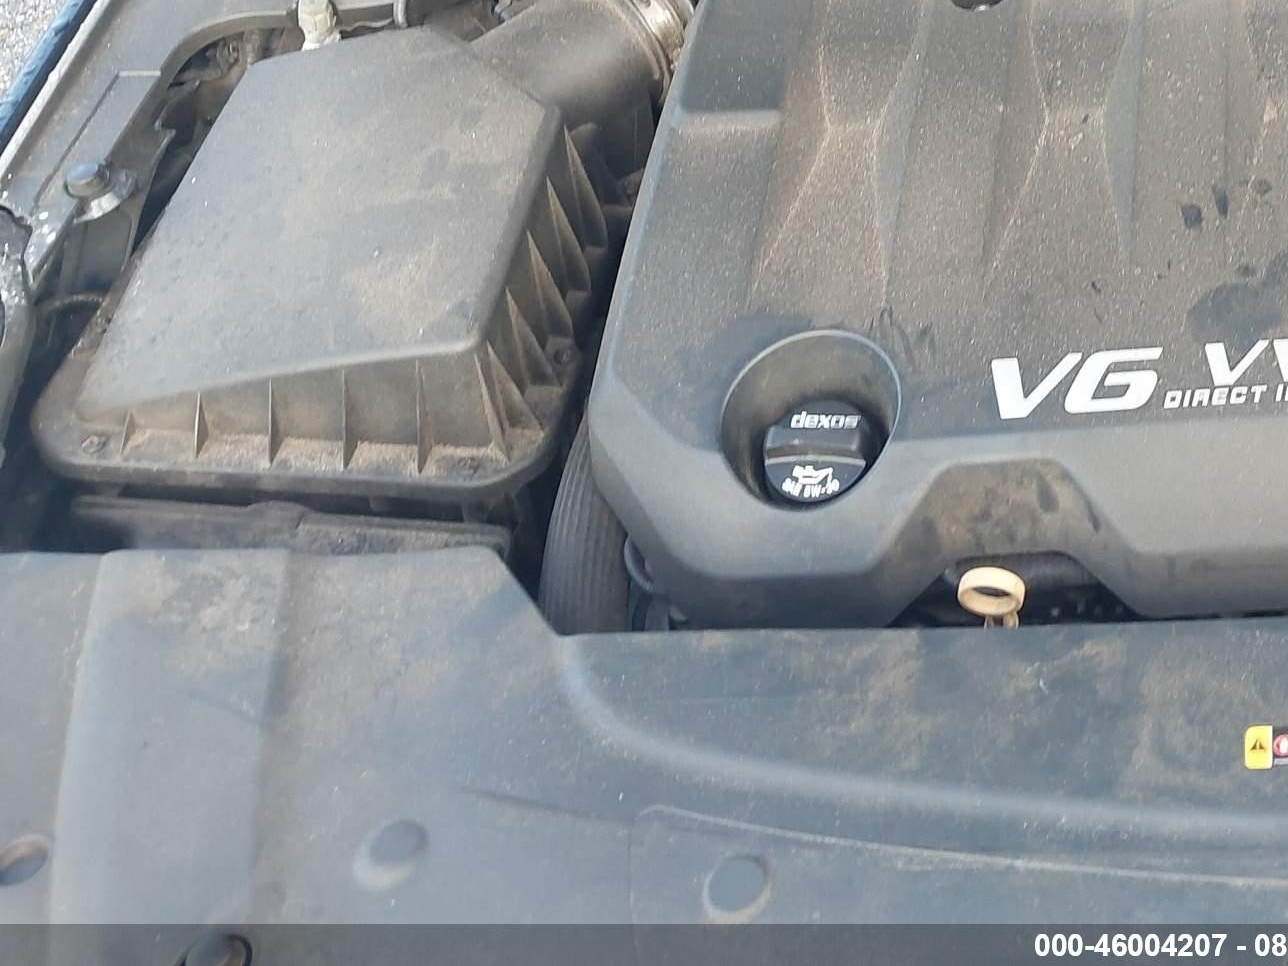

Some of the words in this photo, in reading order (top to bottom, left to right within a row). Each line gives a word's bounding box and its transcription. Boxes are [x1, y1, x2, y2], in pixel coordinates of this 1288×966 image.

[991, 346, 1163, 420] V6
[1163, 384, 1267, 410] DIRECT
[790, 410, 859, 428] dexos
